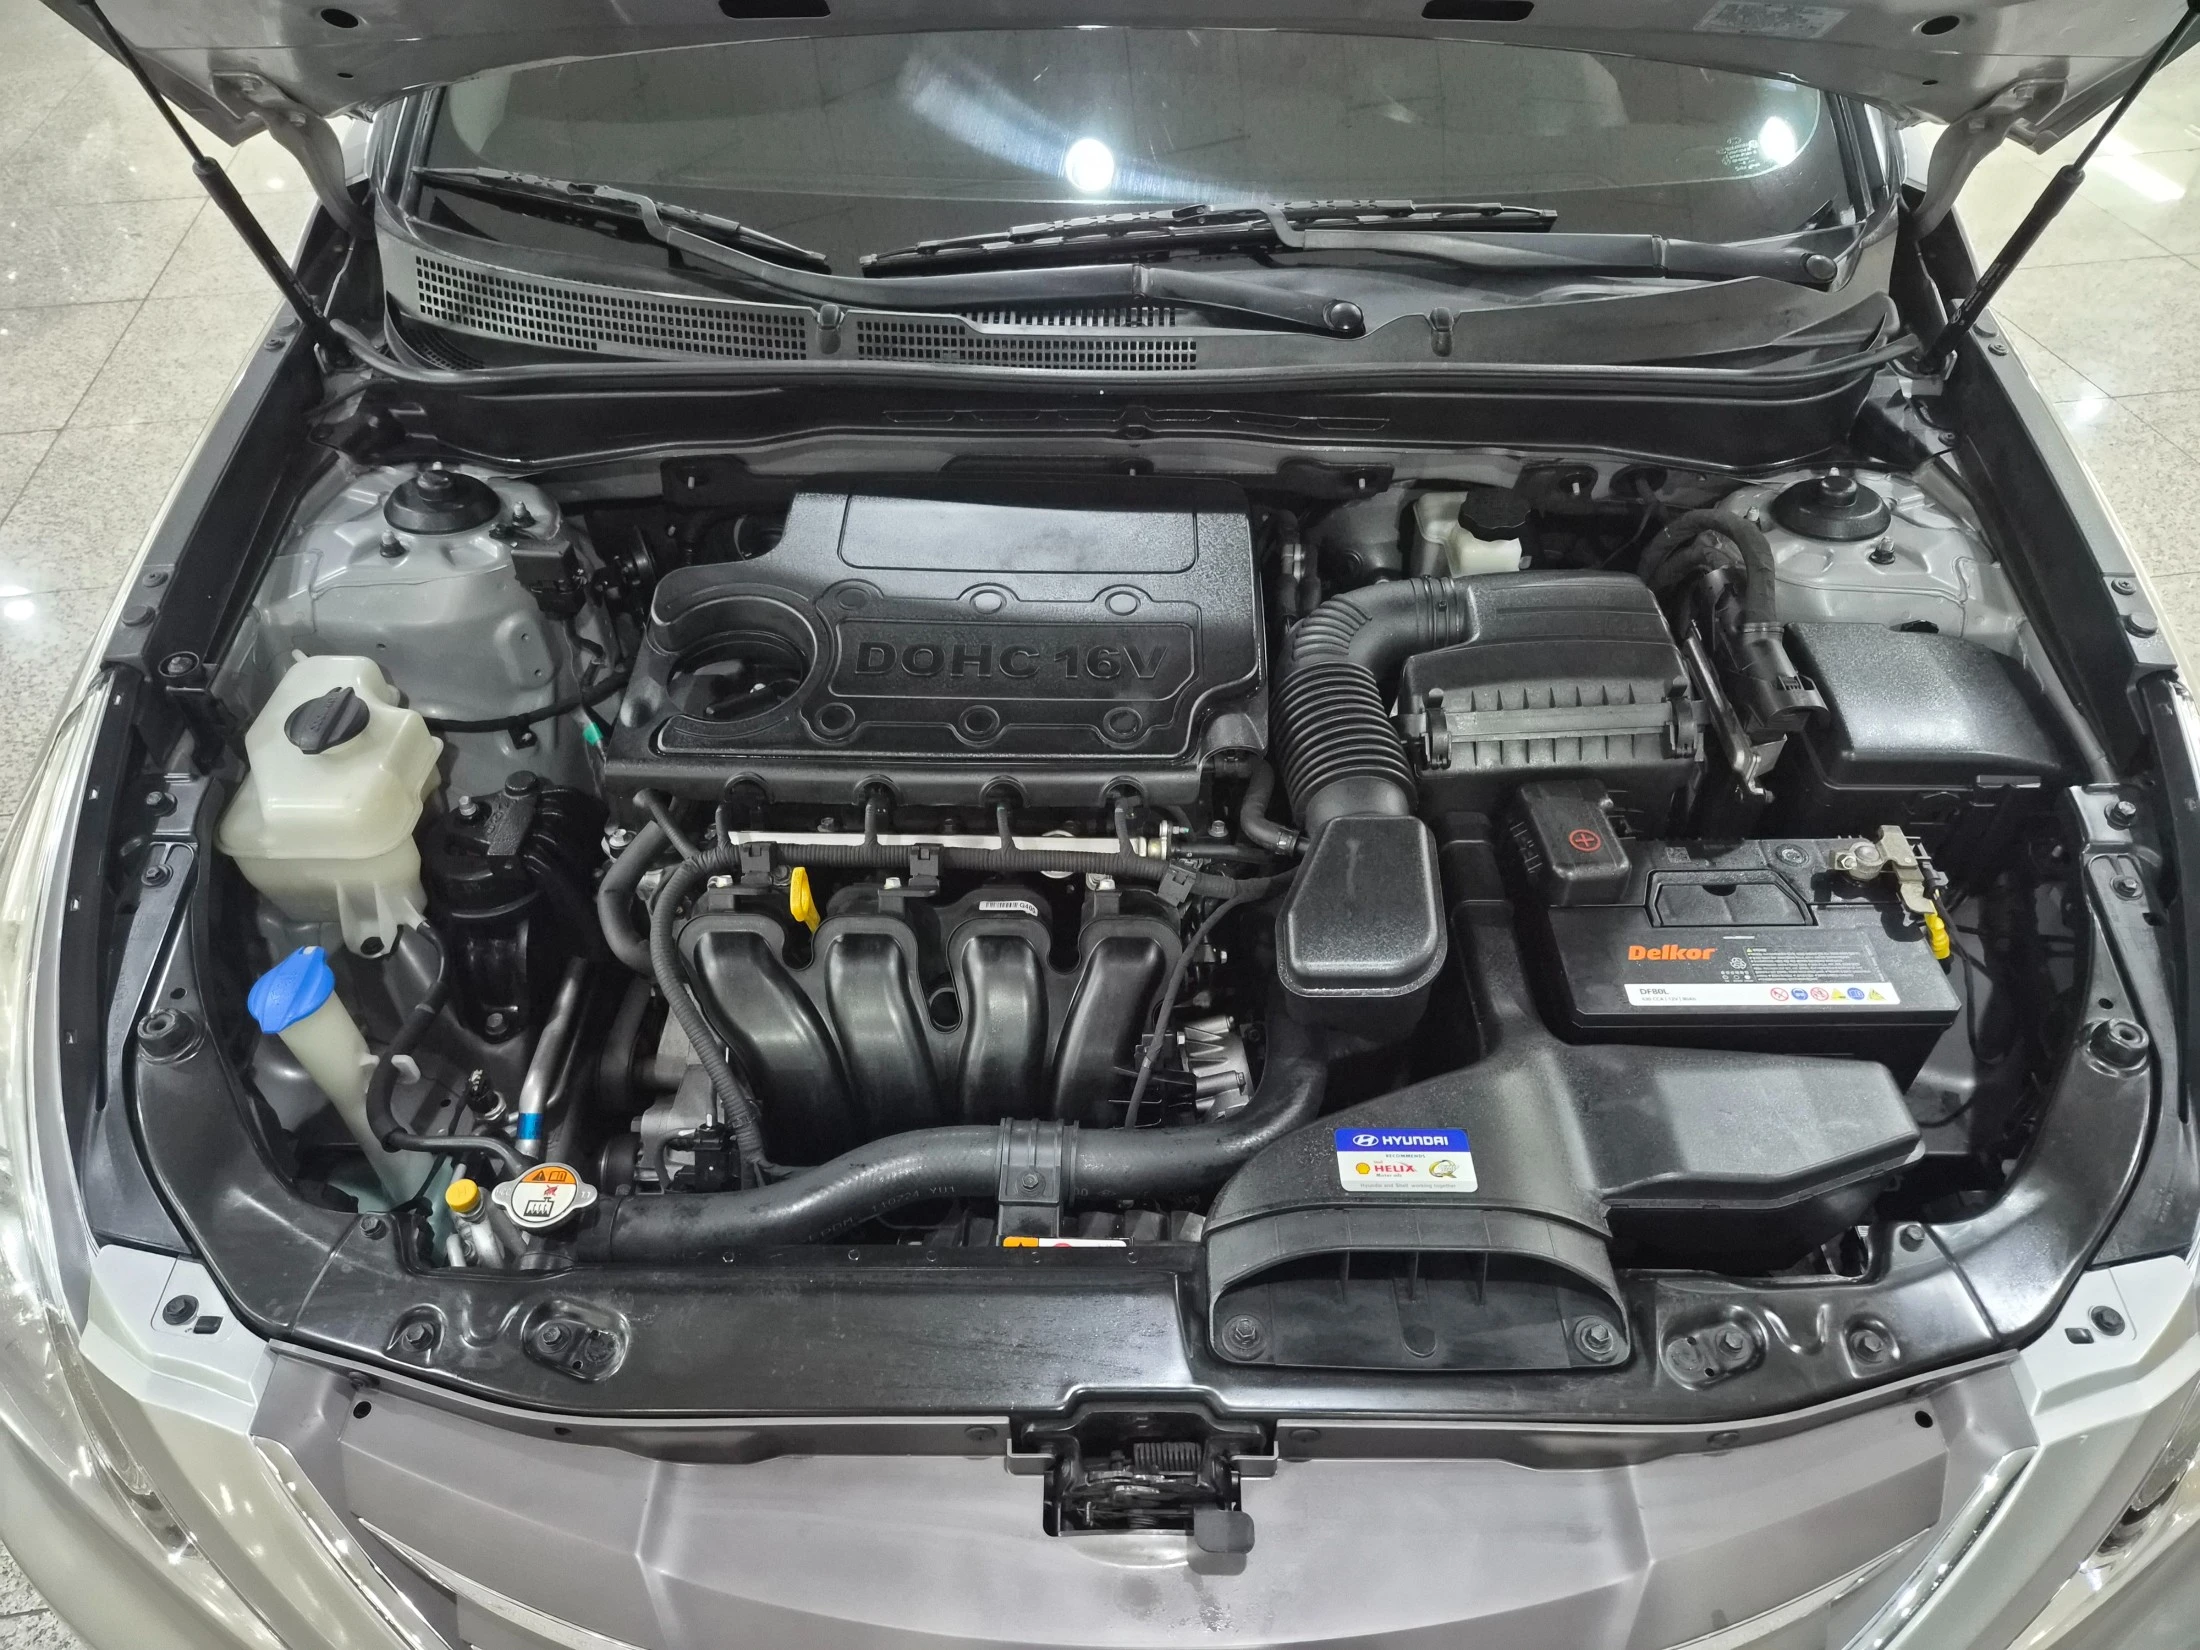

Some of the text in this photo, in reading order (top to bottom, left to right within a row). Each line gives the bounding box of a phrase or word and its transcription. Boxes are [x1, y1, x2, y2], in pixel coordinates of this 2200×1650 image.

[855, 641, 1168, 679] DOHC 16V
[1628, 944, 1716, 961] Delkor
[1382, 1136, 1449, 1146] HYUNDAI
[1374, 1164, 1416, 1173] HELIX
